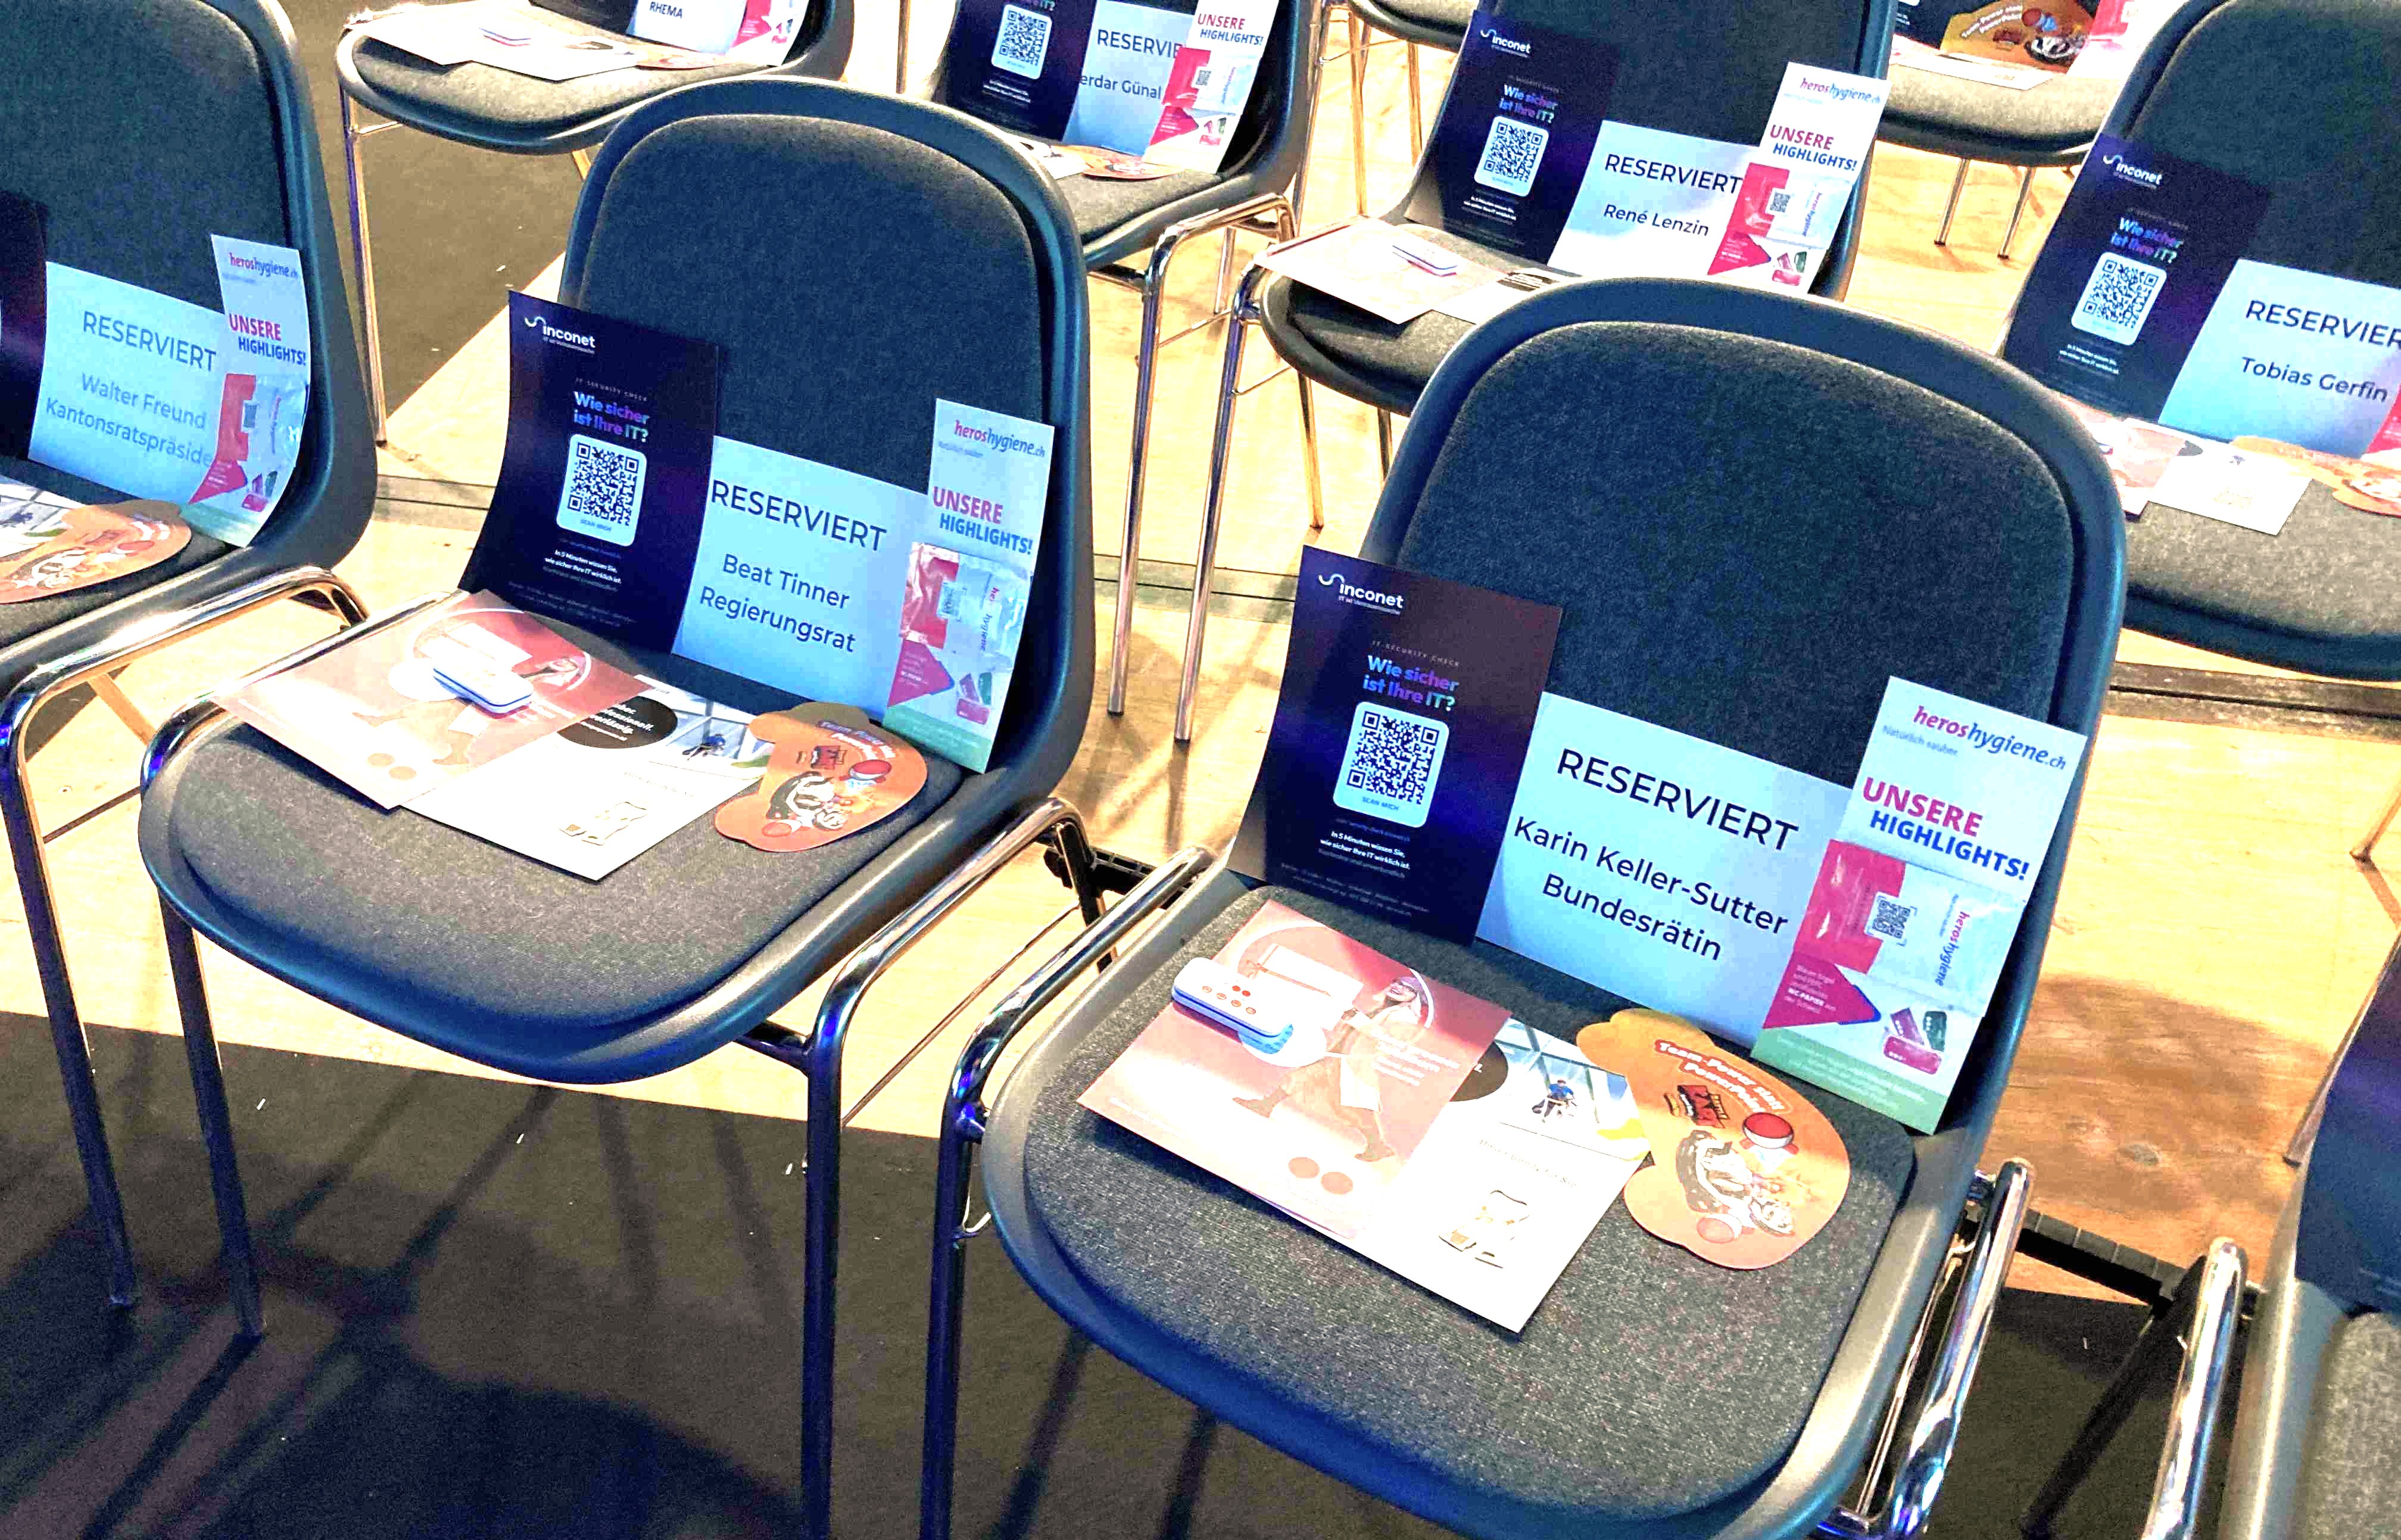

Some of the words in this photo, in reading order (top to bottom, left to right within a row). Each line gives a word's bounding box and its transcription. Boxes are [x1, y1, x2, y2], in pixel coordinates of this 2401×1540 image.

[650, 1, 682, 19] RHEMA
[1198, 13, 1245, 30] UNSERE
[1097, 29, 1183, 58] RESERVIE
[1200, 29, 1264, 46] HIGHLIGHTS!
[1492, 36, 1531, 54] inconet
[1079, 74, 1118, 91] erdar
[1121, 80, 1161, 99] Günal
[1504, 83, 1524, 100] Wie
[1536, 110, 1554, 123] IT?
[1770, 124, 1834, 151] UNSERE
[1773, 142, 1858, 172] HIGHLIGHTS!
[1605, 154, 1743, 194] RESERVIERT
[2116, 163, 2163, 185] inconet
[1604, 204, 1648, 226] René
[1652, 210, 1709, 237] Lenzin
[2119, 217, 2144, 236] Wie
[83, 310, 217, 372] RESERVIERT
[229, 314, 282, 341] UNSERE
[543, 325, 595, 348] inconet
[2246, 299, 2401, 350] RESERVIER
[238, 336, 306, 366] HIGHLIGHTS!
[2241, 356, 2313, 386] Tobias
[2318, 373, 2388, 403] Gerfin
[82, 372, 139, 407] Walter
[144, 394, 207, 429] Freund
[573, 391, 603, 411] Wie
[604, 402, 650, 424] sicher
[46, 397, 212, 467] Kantonsratspräside
[573, 409, 592, 426] ist
[594, 415, 623, 435] Ihre
[625, 424, 649, 443] IT?
[954, 419, 1046, 457] heroshygiene.ch
[711, 479, 887, 552] RESERVIERT
[933, 486, 1003, 525] UNSERE
[939, 513, 1033, 555] HIGHLIGHTS!
[722, 553, 773, 587] Beat
[779, 570, 850, 610] Tinner
[1340, 584, 1404, 609] inconet
[699, 585, 857, 653] Regierungsrat
[1386, 643, 1427, 658] SECURITY
[1430, 655, 1460, 668] CHECK
[1368, 654, 1402, 677] Wie
[1404, 666, 1460, 692] sicher
[1362, 674, 1386, 695] ist
[1387, 681, 1424, 704] Ihre
[1425, 691, 1456, 712] IT?
[1913, 705, 2067, 771] heroshygiene.ch
[1557, 748, 1800, 852] RESERVIERT
[1863, 777, 1984, 837] UNSERE
[1330, 830, 1339, 838] In
[1343, 834, 1371, 847] Minuten
[1370, 843, 1393, 854] wissen
[1332, 842, 1353, 853] sicher
[1352, 847, 1367, 857] Ihre
[1374, 855, 1400, 868] wirklich
[1869, 810, 2030, 881] HIGHLIGHTS!
[1513, 815, 1589, 861] Karin
[1595, 844, 1789, 935] Keller-Sutter
[1542, 872, 1723, 961] Bundesrätin
